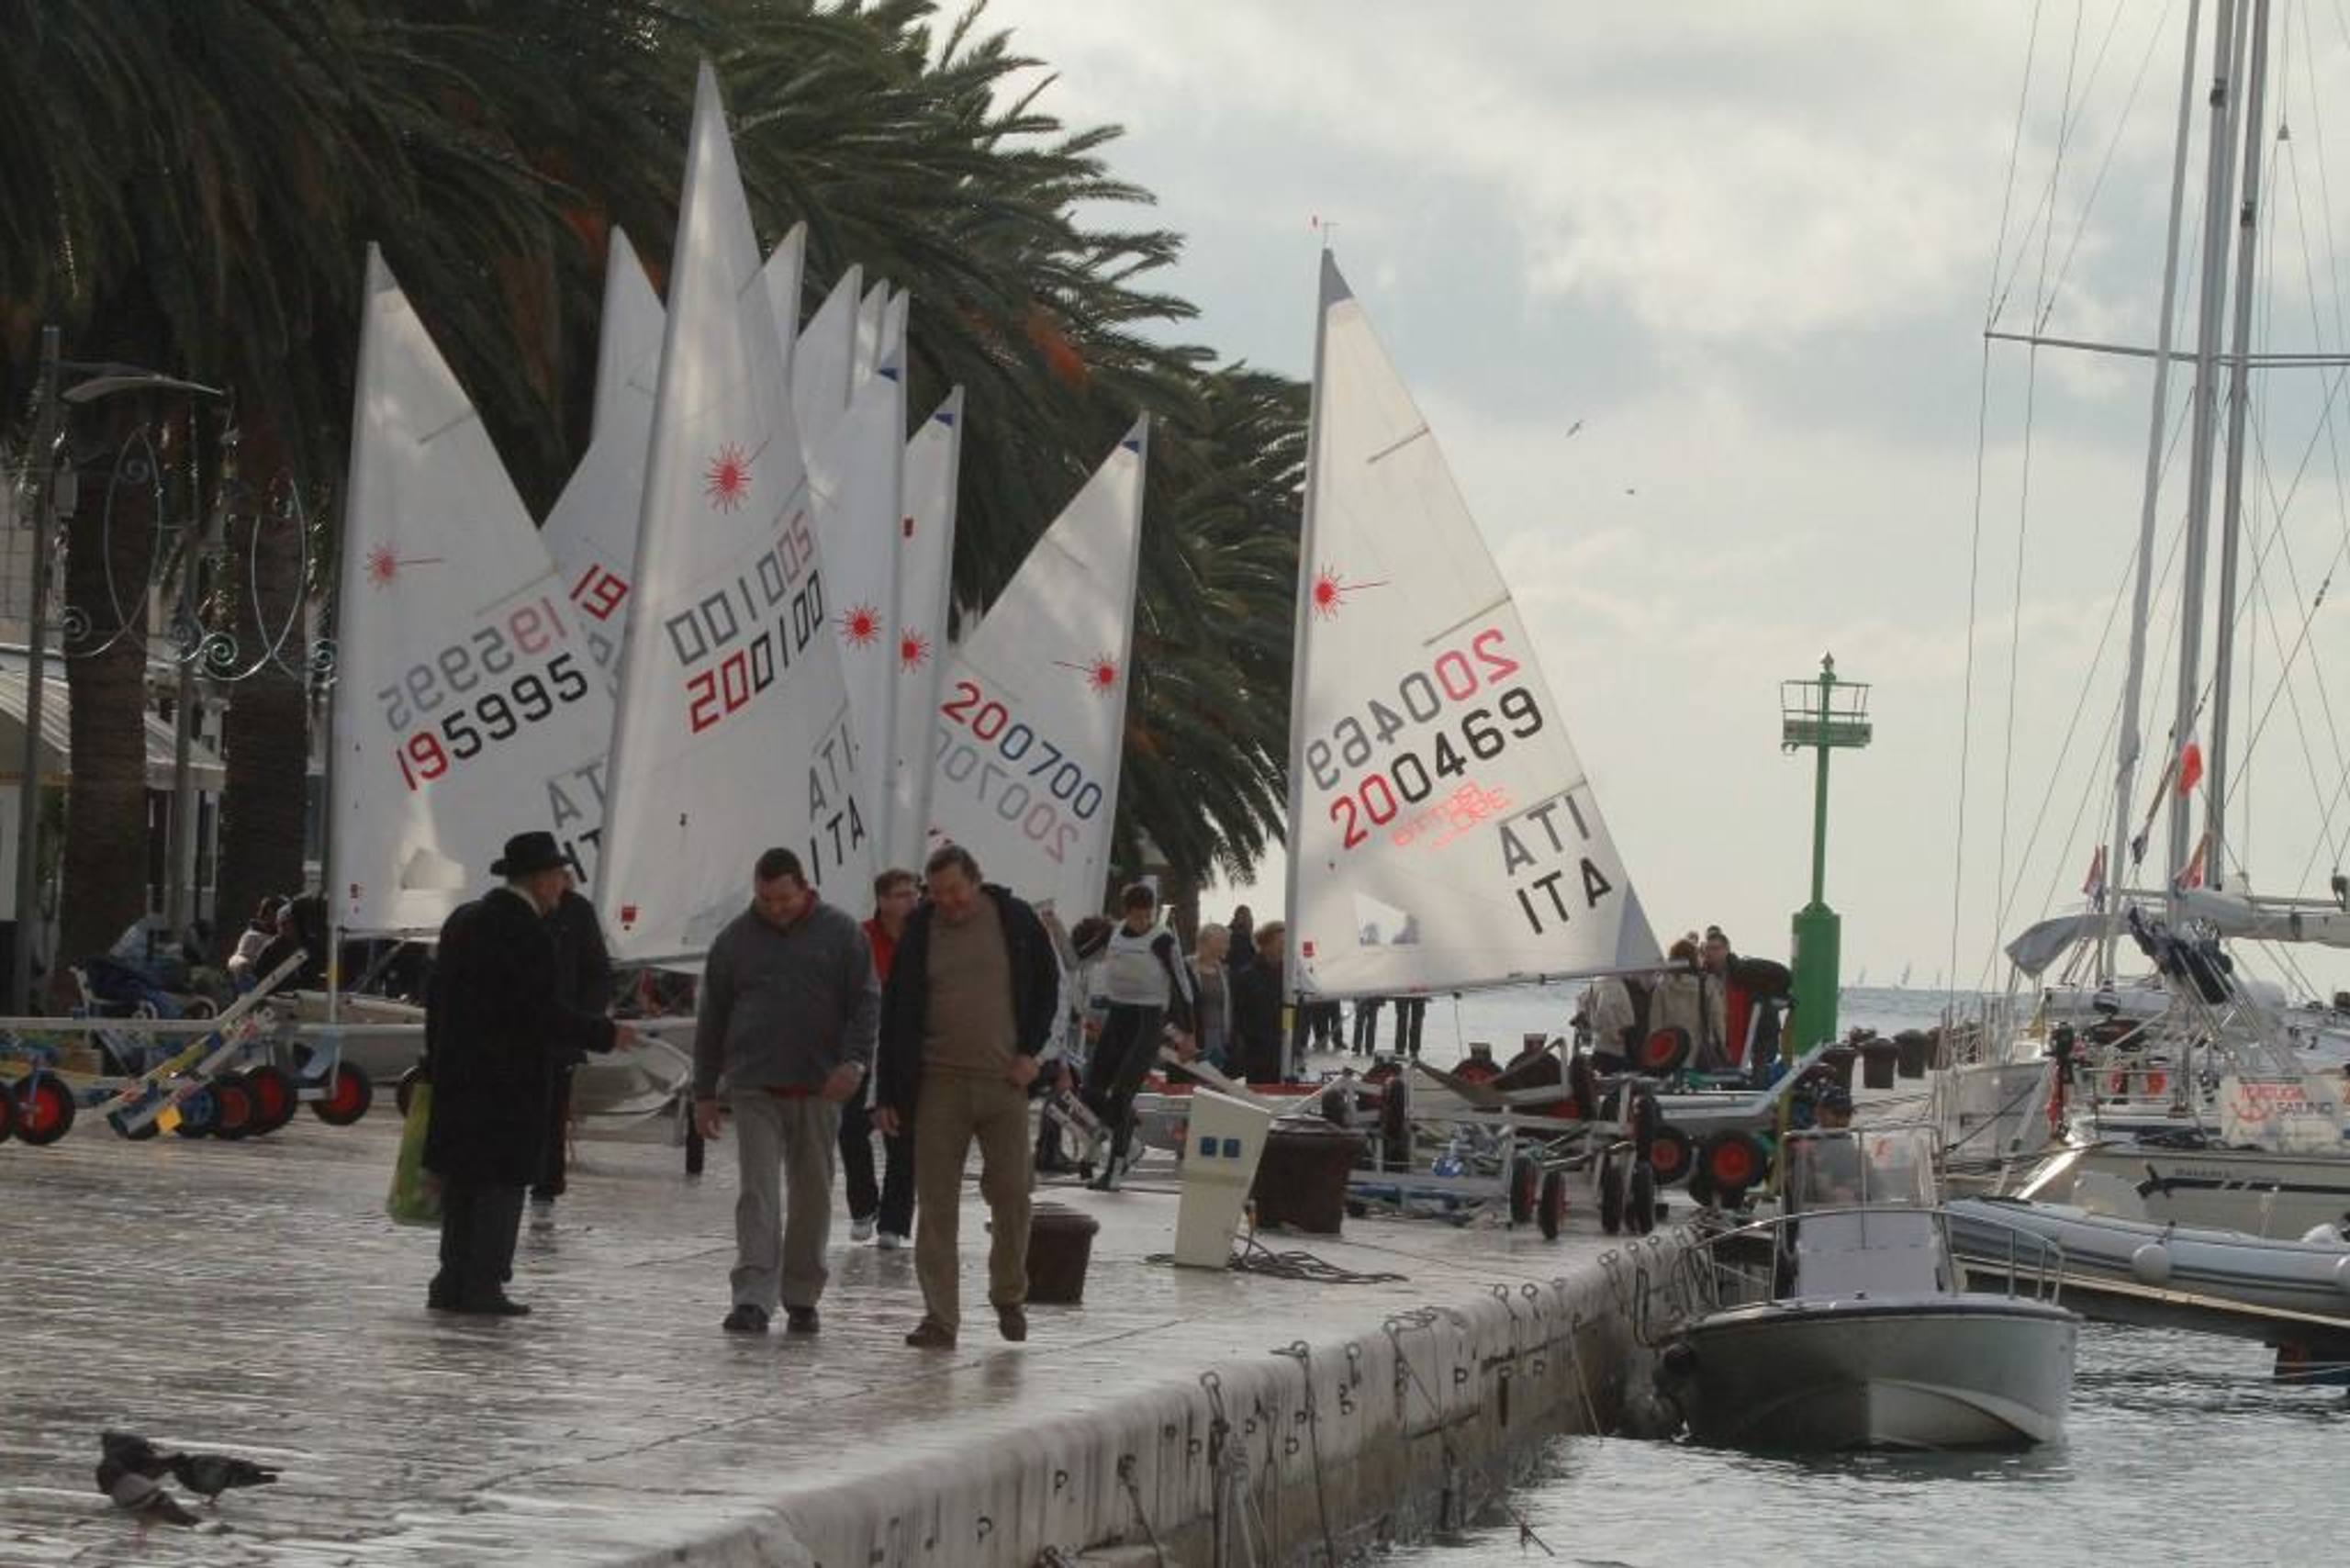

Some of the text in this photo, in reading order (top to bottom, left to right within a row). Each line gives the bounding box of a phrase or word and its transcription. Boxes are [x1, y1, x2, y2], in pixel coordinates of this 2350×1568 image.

[686, 569, 823, 734] 200100
[396, 653, 588, 791] 195995
[940, 681, 1102, 820] 200700
[1329, 687, 1543, 849] 200469
[810, 795, 865, 886] ITA
[1516, 857, 1612, 935] ITA
